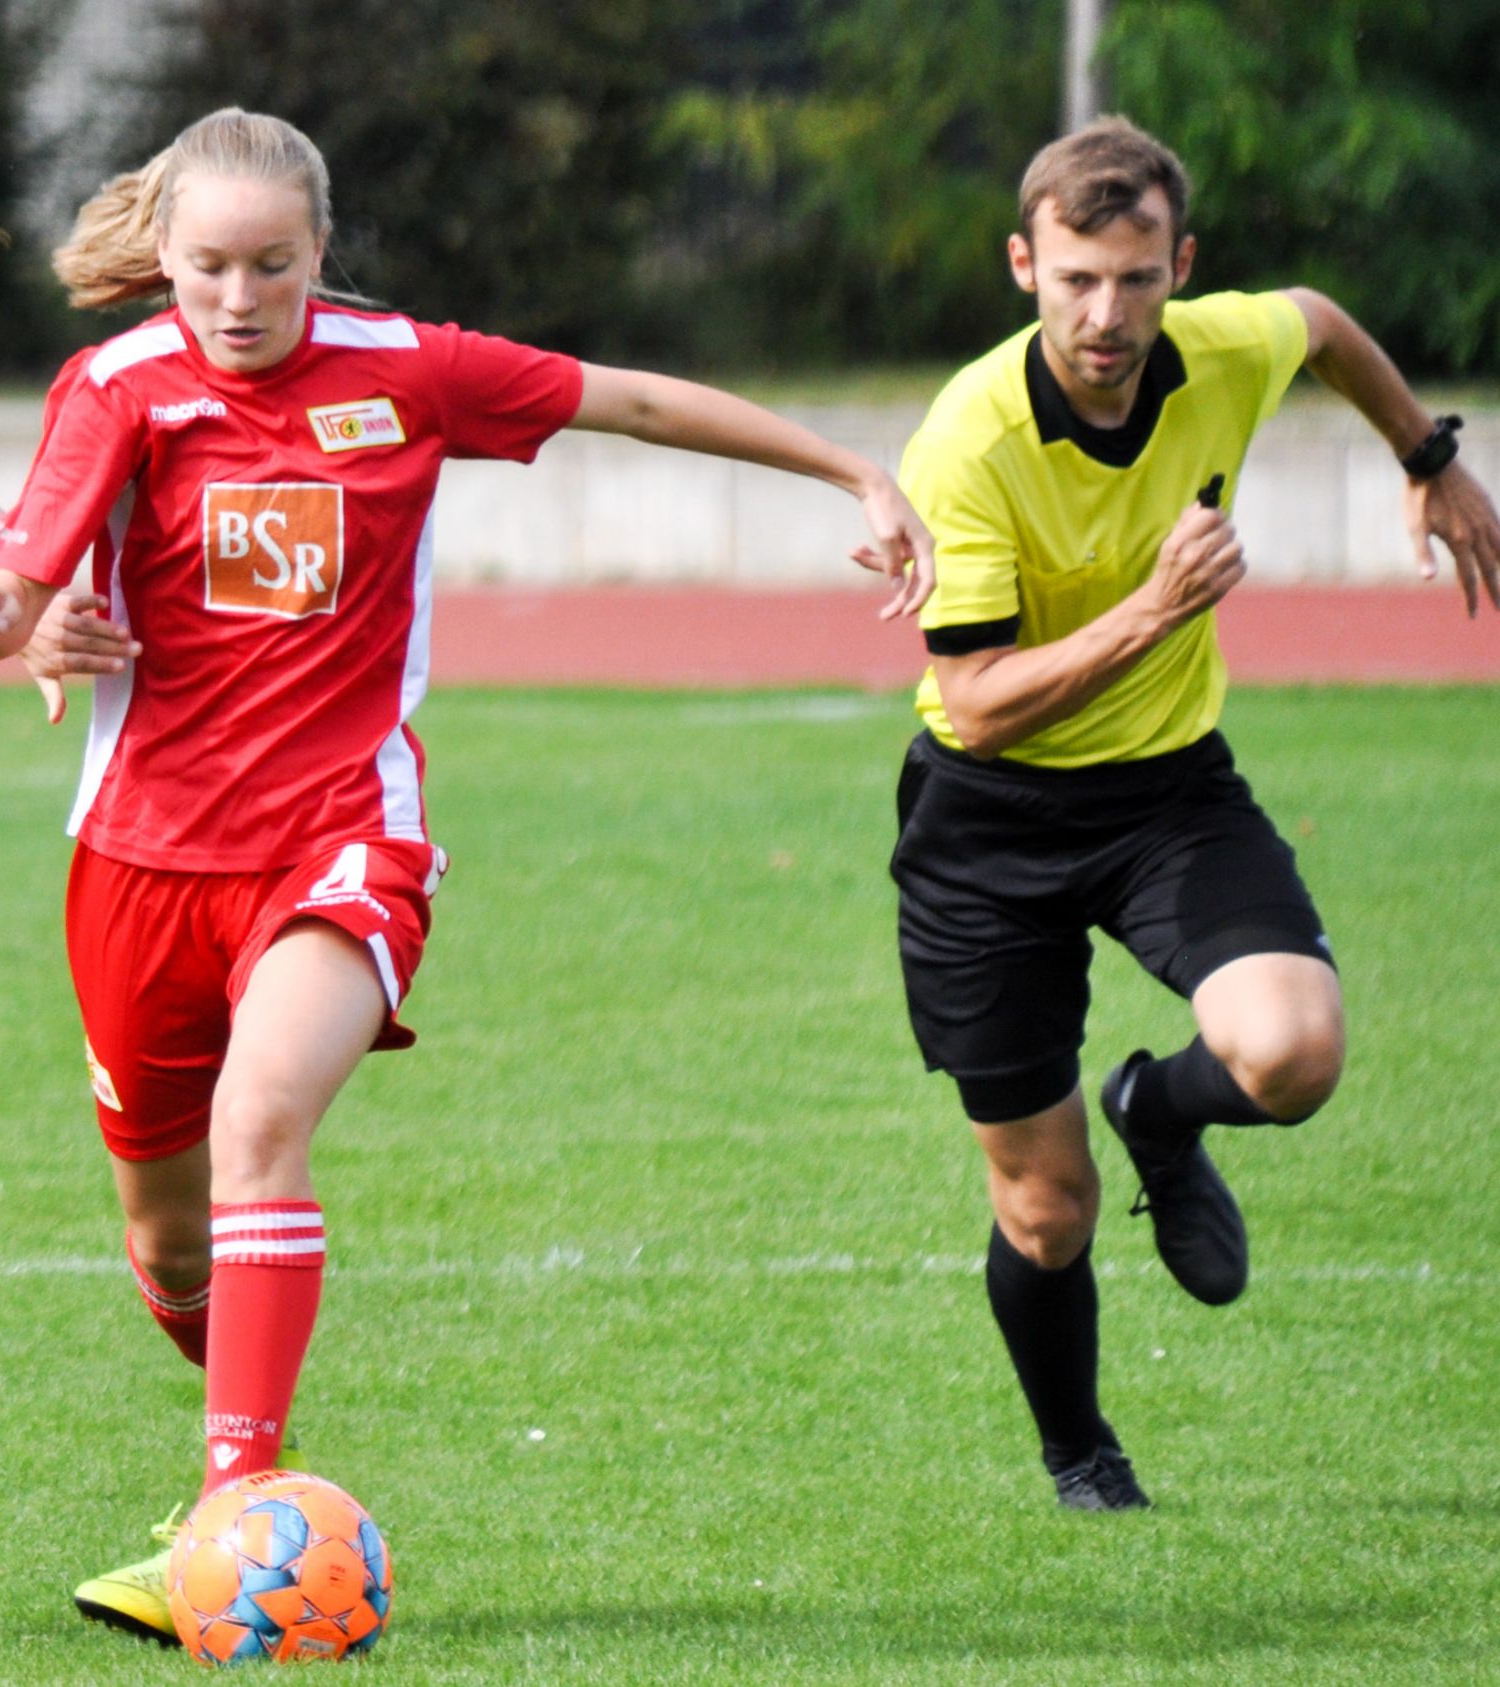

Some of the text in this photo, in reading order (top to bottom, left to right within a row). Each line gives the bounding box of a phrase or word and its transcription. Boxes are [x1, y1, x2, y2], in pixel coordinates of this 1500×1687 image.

[151, 398, 228, 422] macron
[219, 511, 327, 594] BSR
[309, 843, 369, 899] 4
[213, 1413, 277, 1434] UNION
